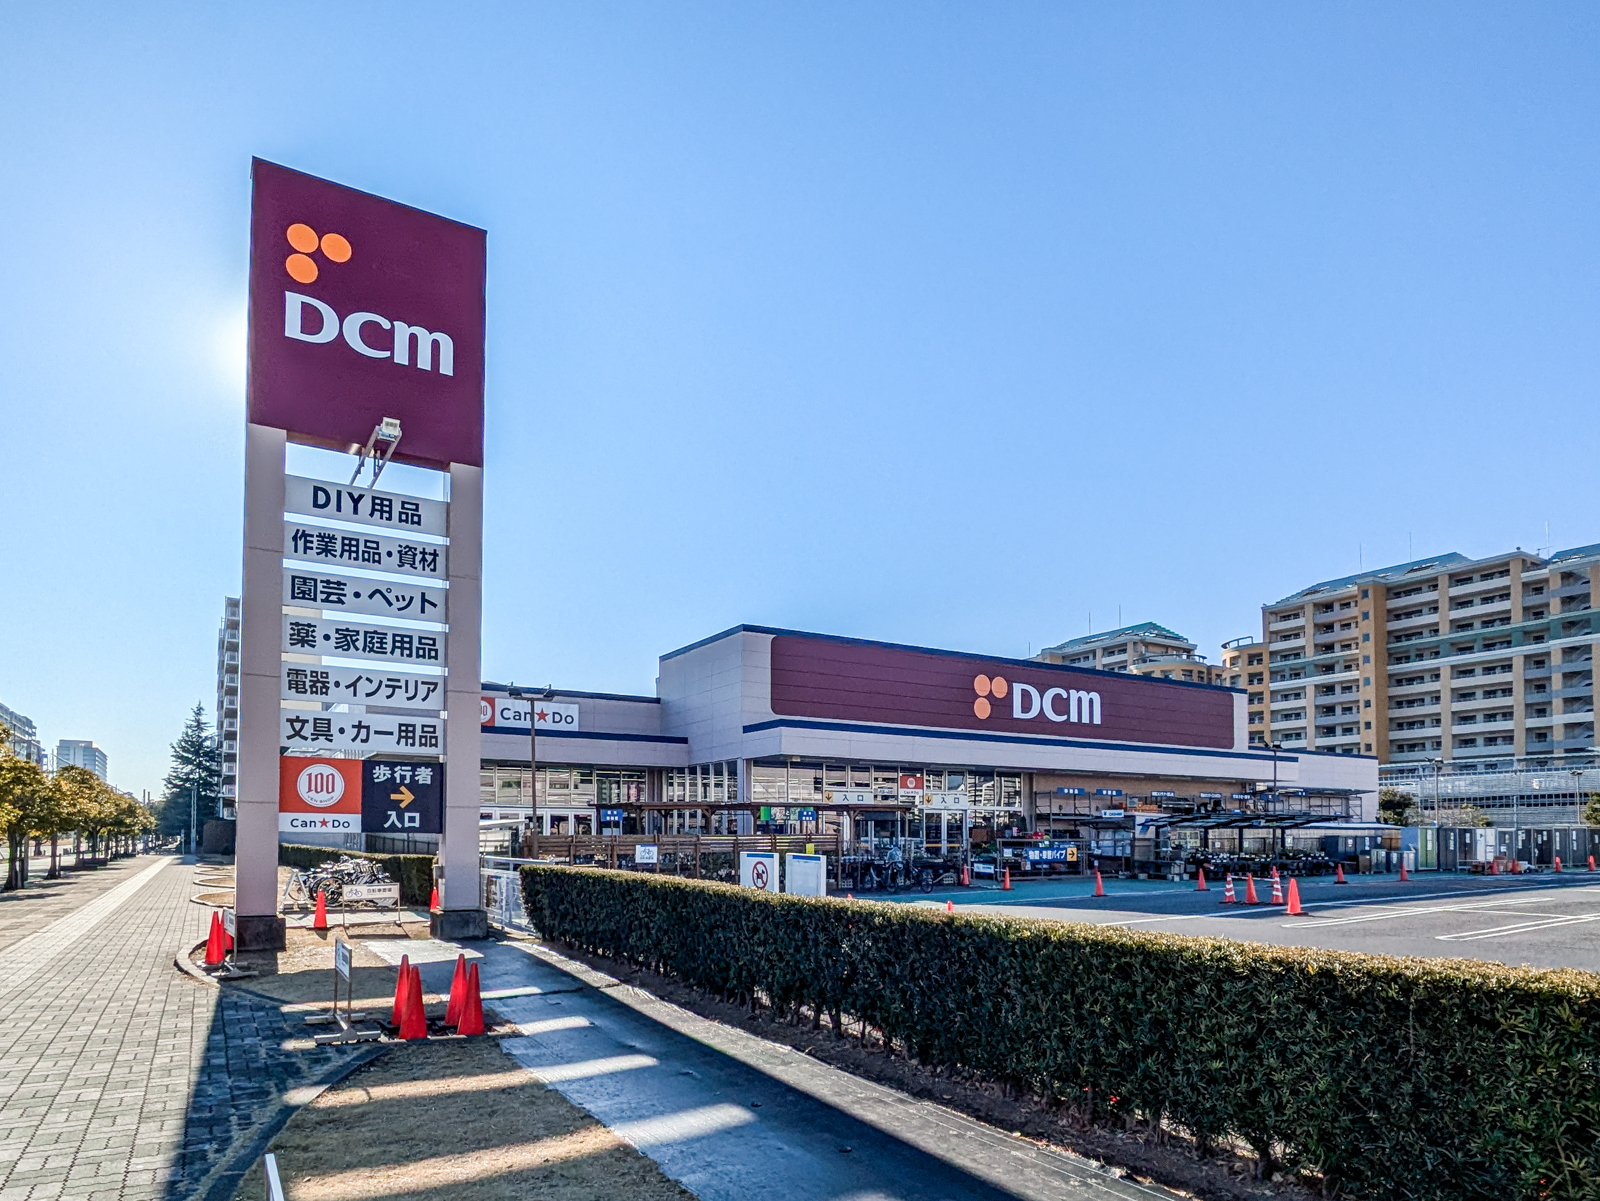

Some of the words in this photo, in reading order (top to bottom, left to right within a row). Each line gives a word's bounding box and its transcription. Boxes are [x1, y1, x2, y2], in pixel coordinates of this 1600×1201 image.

[312, 485, 422, 526] DIY用品
[291, 528, 439, 573] 作業用品・資材
[290, 574, 438, 615] 園芸・ペット
[289, 621, 439, 661] 薬・家庭用品
[286, 668, 439, 702] 電器・インテリア
[286, 716, 439, 748] 文具・カー用品
[306, 772, 336, 794] 100
[372, 764, 434, 785] 歩行者
[842, 794, 864, 802] 入口
[383, 811, 420, 828] 入口
